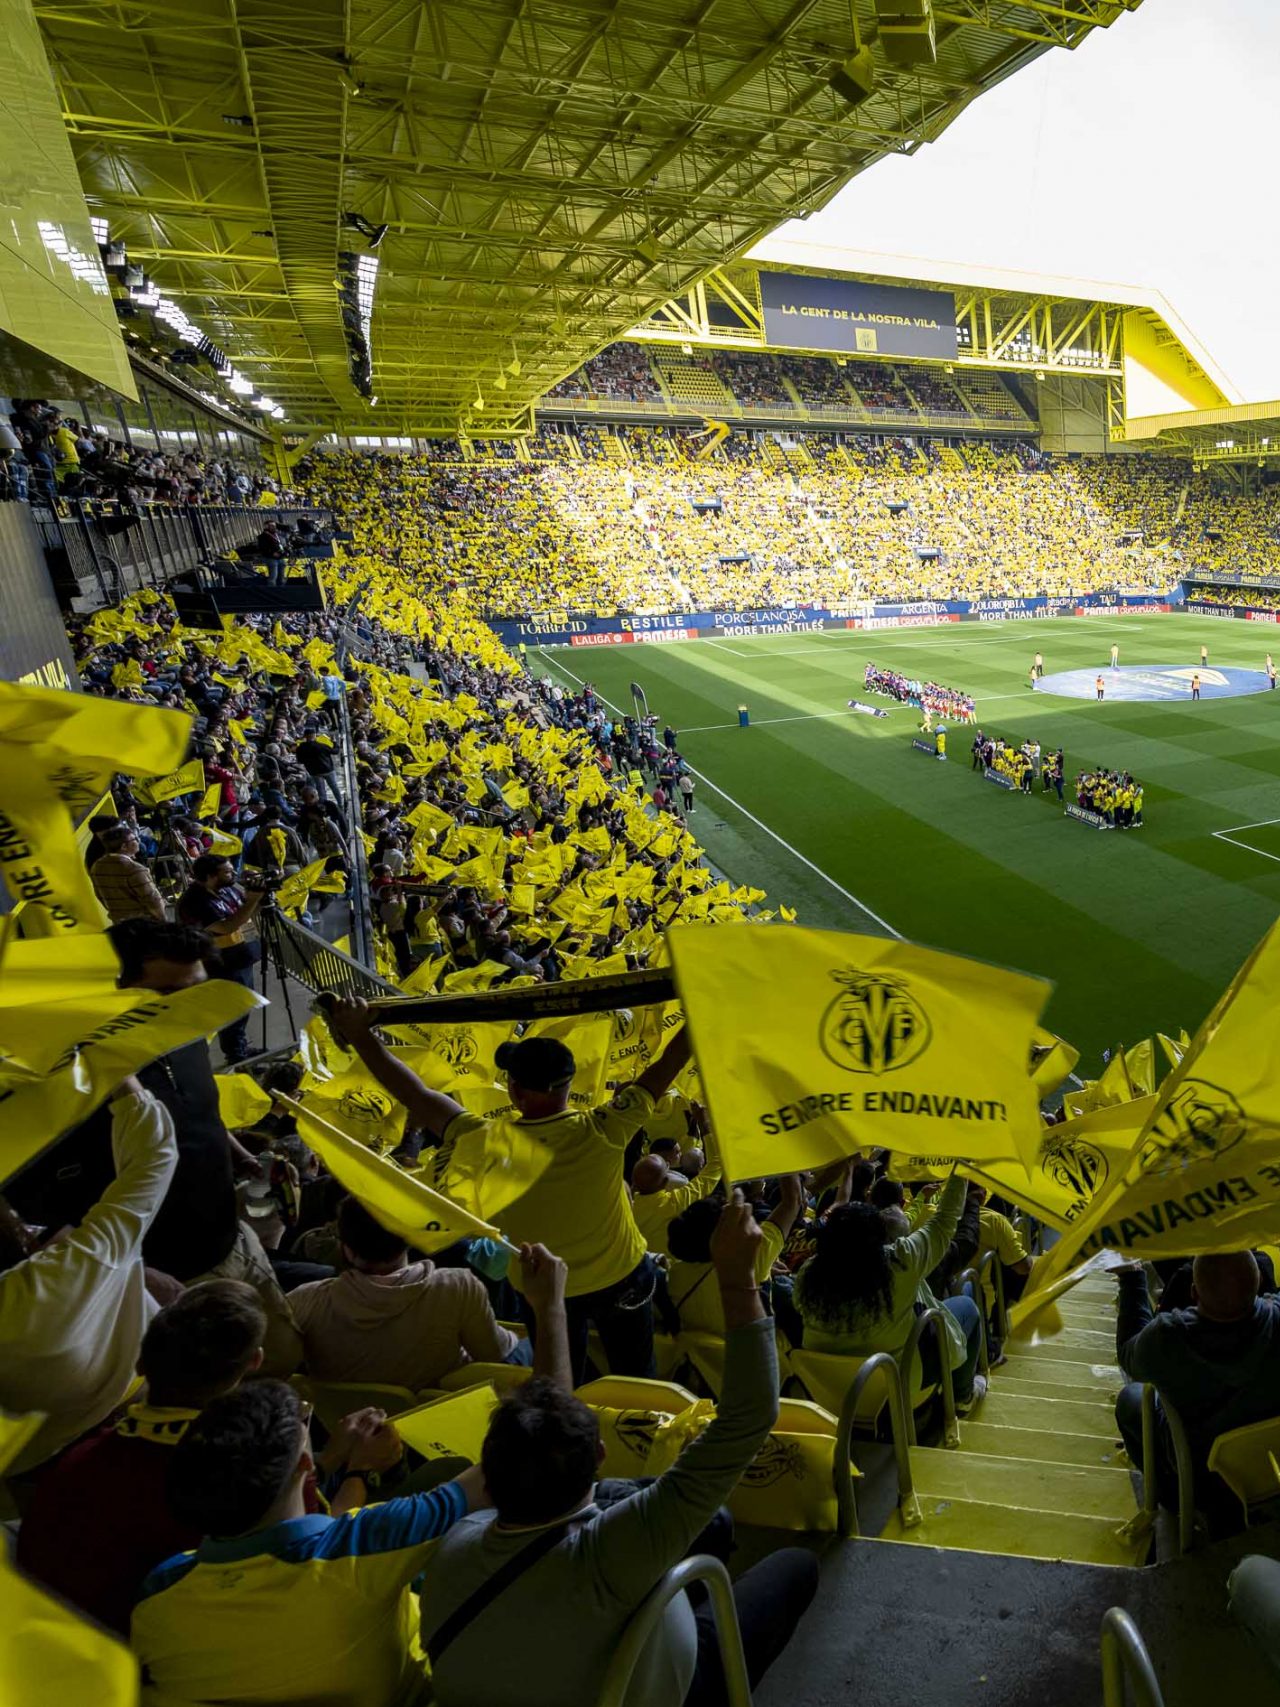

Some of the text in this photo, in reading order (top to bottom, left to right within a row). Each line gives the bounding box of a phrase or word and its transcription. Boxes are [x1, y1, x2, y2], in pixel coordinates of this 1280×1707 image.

[781, 304, 941, 330] LA GENT DE LA NOSTRA VILA,
[901, 602, 948, 615] ARGENTA
[979, 608, 1058, 621] MORE THAN TILES
[1083, 605, 1119, 616] PAMESA
[1188, 605, 1204, 615] MORE
[1205, 607, 1220, 617] THAN
[1251, 613, 1277, 623] PAMESA
[724, 621, 824, 637] MORE THAN TILES
[575, 629, 689, 646] LALIGA PAMESA
[863, 1091, 1008, 1122] ENDAVANT!
